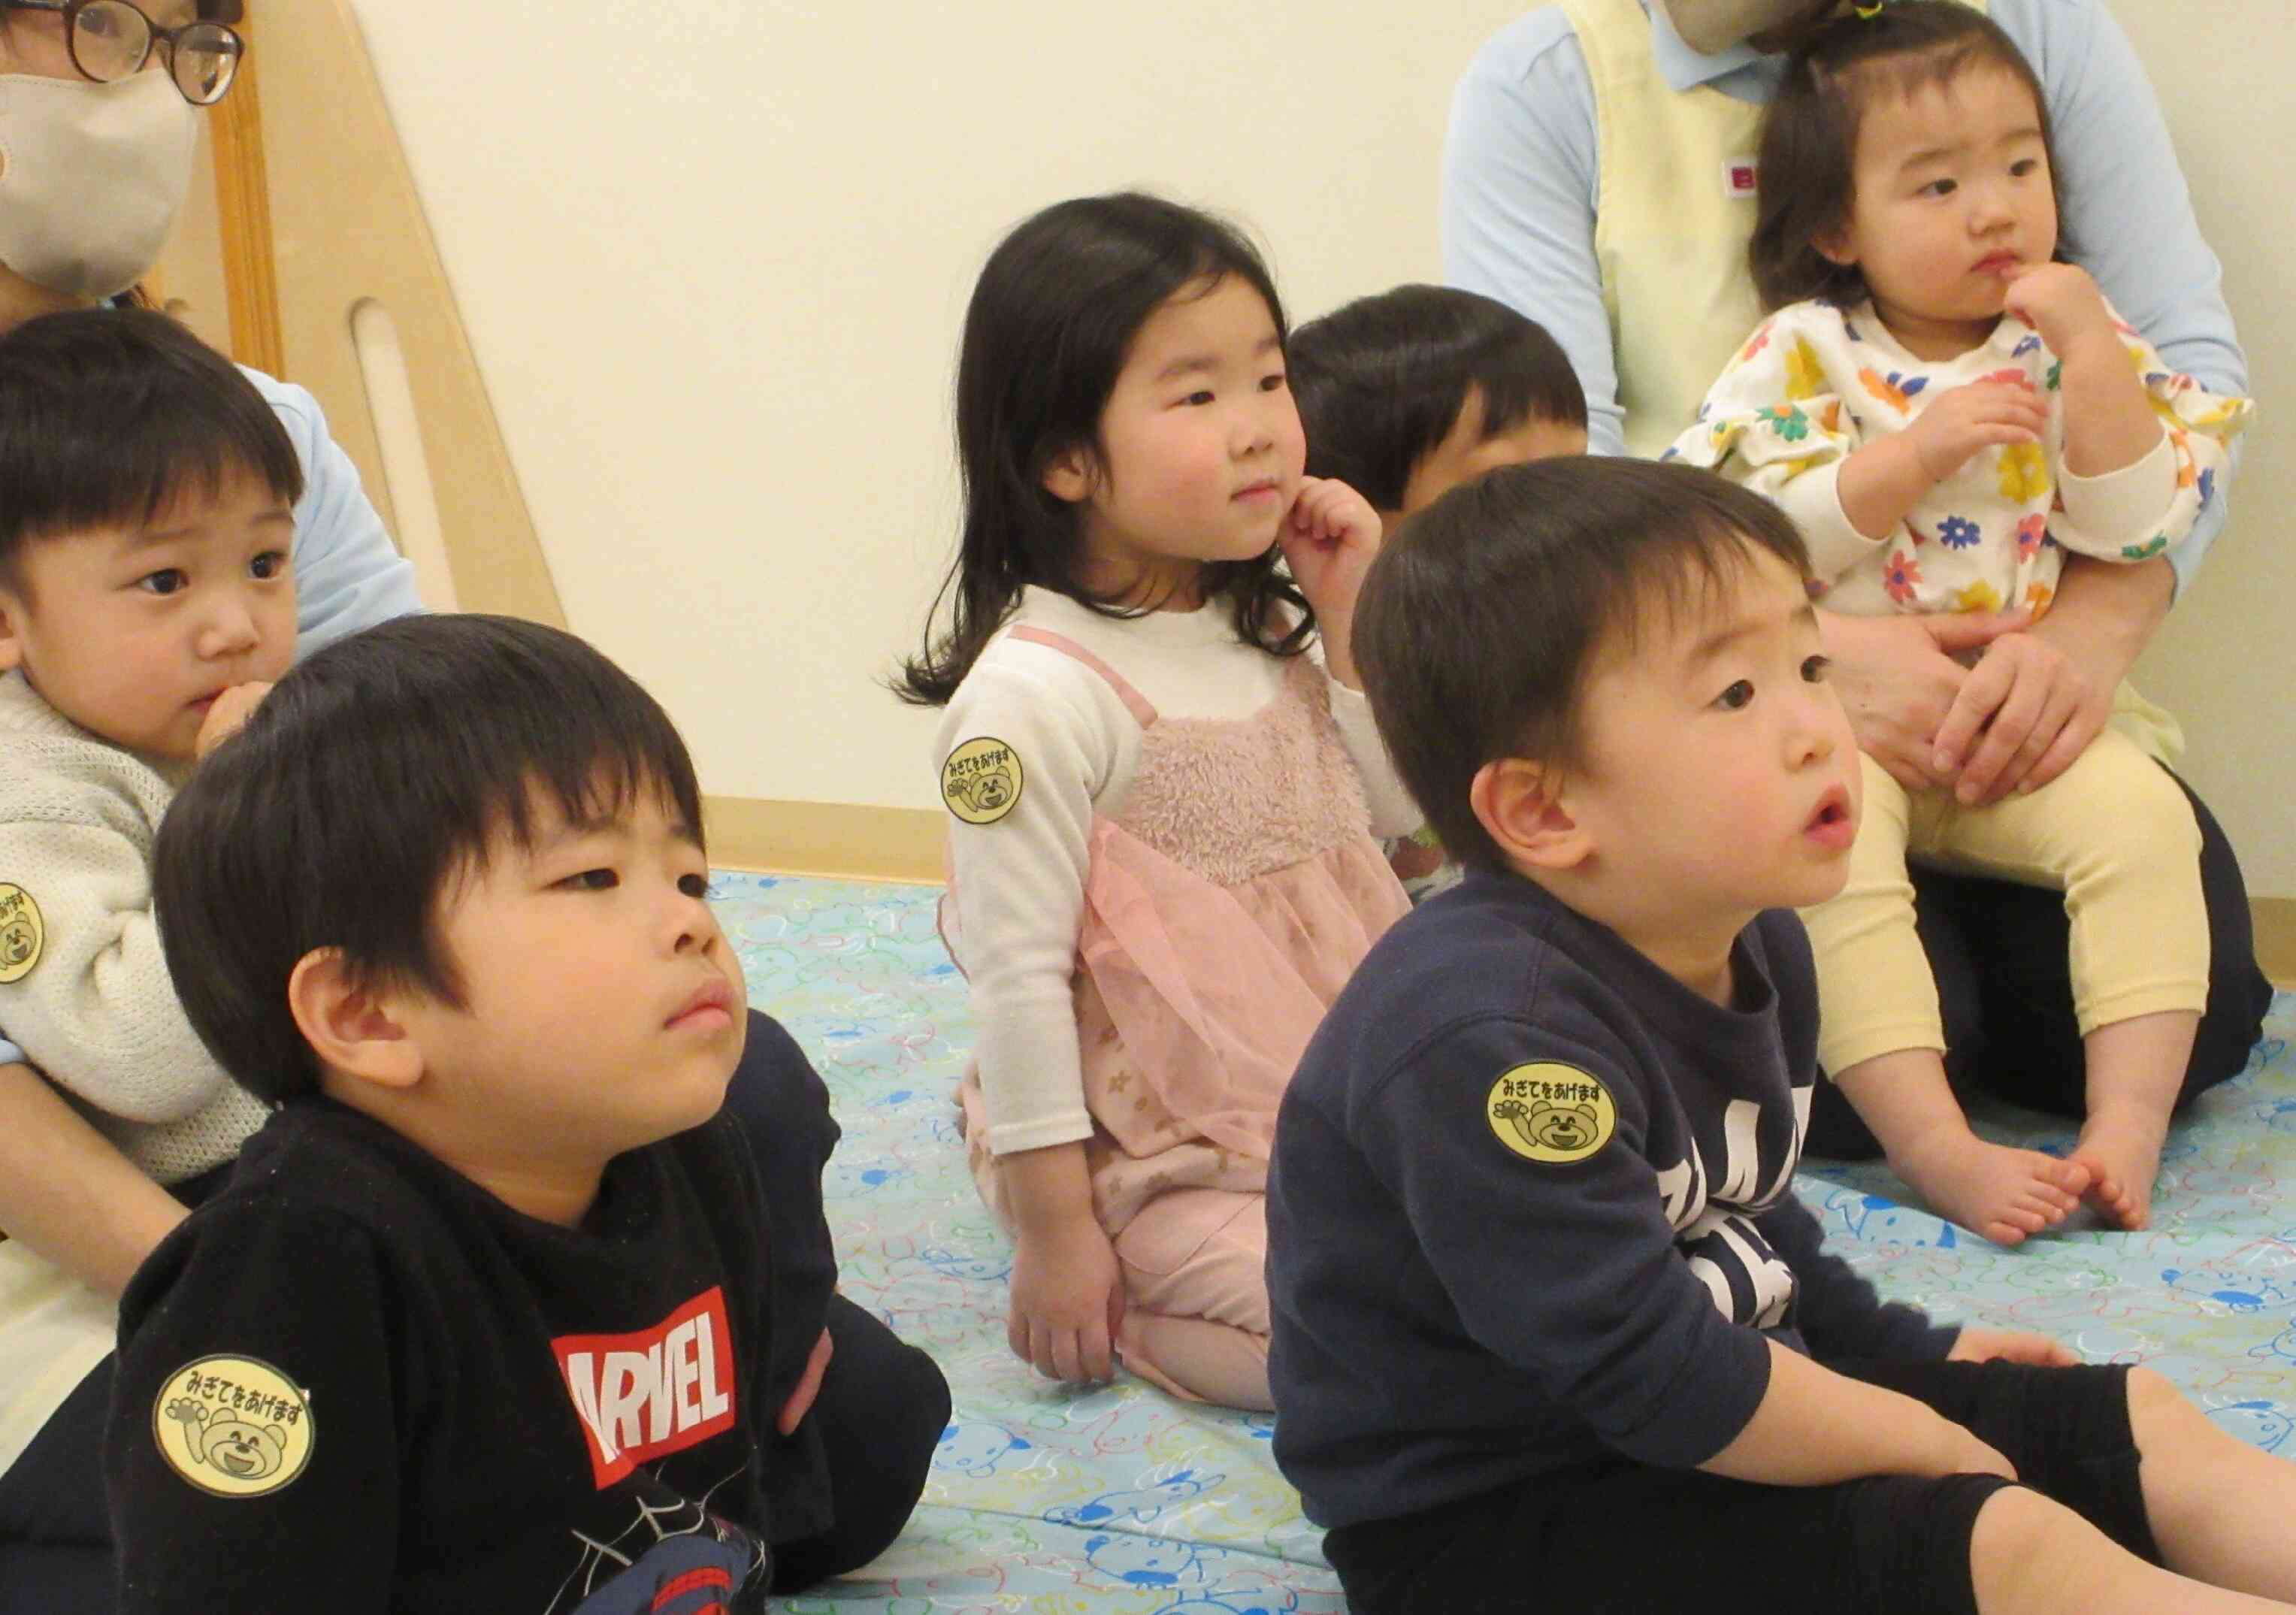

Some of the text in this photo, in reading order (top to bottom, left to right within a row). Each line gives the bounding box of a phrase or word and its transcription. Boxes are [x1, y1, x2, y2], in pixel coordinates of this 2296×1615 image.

[948, 747, 1010, 777] みぎてをあげます
[1503, 1078, 1601, 1102] みぎてをあげます
[186, 1370, 303, 1426] みぎてをあげます
[567, 1311, 729, 1465] ARVEL
